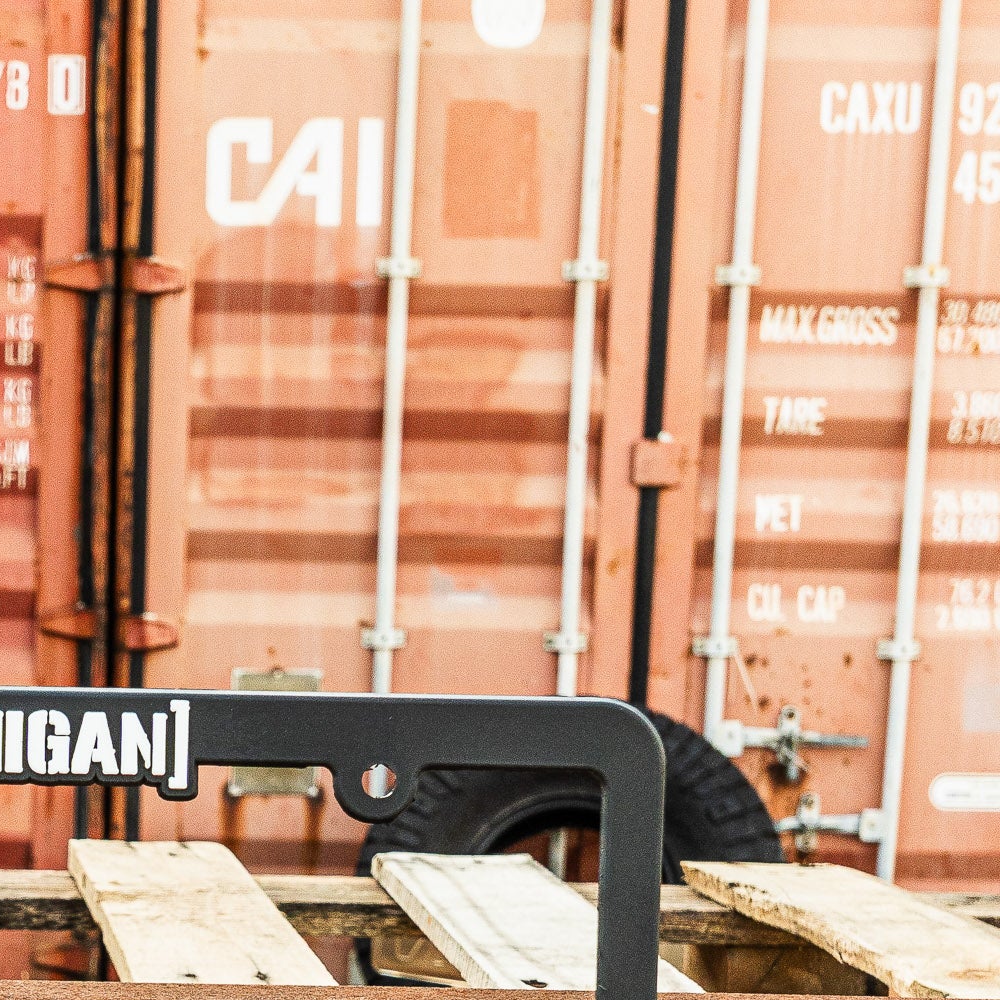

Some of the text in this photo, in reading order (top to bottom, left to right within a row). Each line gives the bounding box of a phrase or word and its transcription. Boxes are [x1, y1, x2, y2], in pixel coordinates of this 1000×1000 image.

[820, 80, 923, 134] CAXU
[205, 117, 385, 228] CAI
[763, 395, 829, 437] TARE
